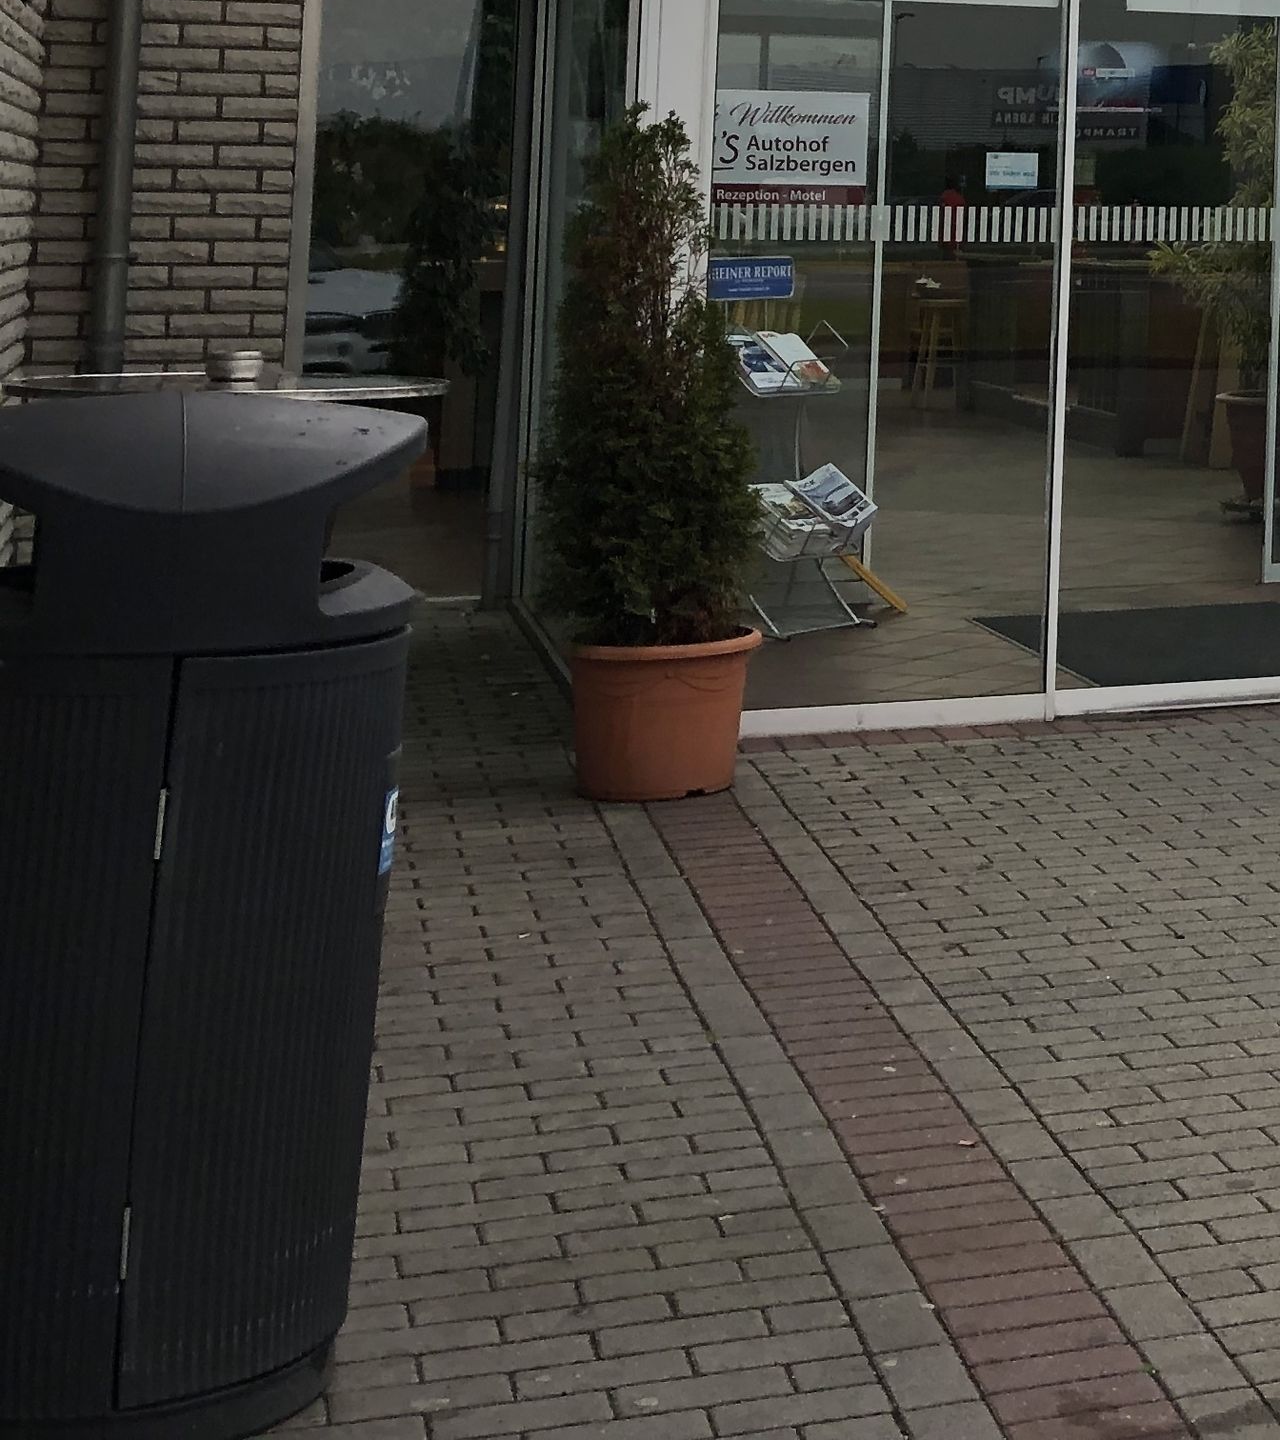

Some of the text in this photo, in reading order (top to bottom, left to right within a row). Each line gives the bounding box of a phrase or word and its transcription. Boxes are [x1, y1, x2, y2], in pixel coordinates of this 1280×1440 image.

[729, 101, 856, 128] Willkommen
[746, 135, 830, 153] Autohof
[745, 154, 856, 176] Salzbergen
[716, 189, 780, 203] Rezeption
[790, 189, 826, 202] Motel
[754, 265, 792, 278] REPORT
